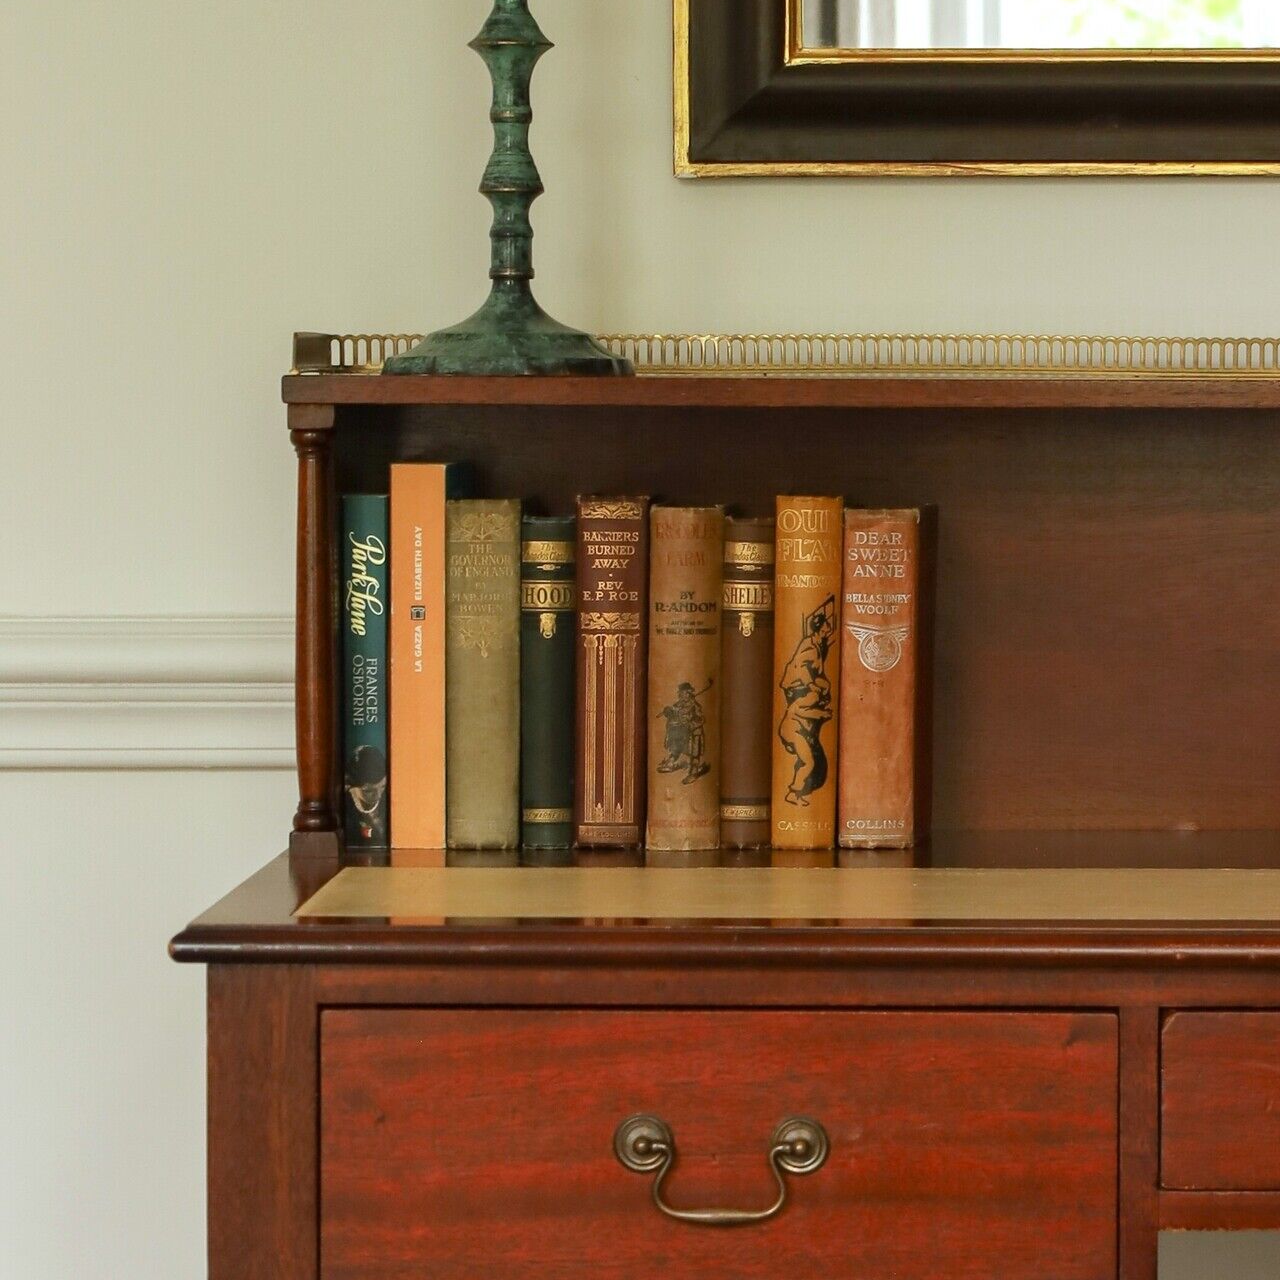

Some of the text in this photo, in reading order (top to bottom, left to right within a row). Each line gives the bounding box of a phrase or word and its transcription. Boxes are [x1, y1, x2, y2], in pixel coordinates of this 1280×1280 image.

[583, 531, 639, 542] BARRIERS
[854, 531, 902, 545] DEAR
[468, 543, 493, 554] THE
[587, 544, 636, 556] BURNED
[741, 543, 757, 552] The
[848, 548, 912, 562] SWEET
[414, 526, 423, 601] ELIZABETH DAY
[591, 558, 630, 569] AWAY
[853, 564, 906, 578] ANNE
[346, 531, 386, 637] Park Lane
[597, 581, 624, 591] REV.
[525, 586, 572, 605] HOOD
[608, 591, 639, 601] ROE
[680, 590, 695, 600] BY
[845, 593, 876, 604] BELLA
[854, 604, 899, 615] WOOLF
[414, 625, 423, 673] LA GAZZA
[353, 654, 365, 726] OSBORNE
[366, 657, 378, 723] FRANCES
[846, 819, 905, 830] COLLINS
